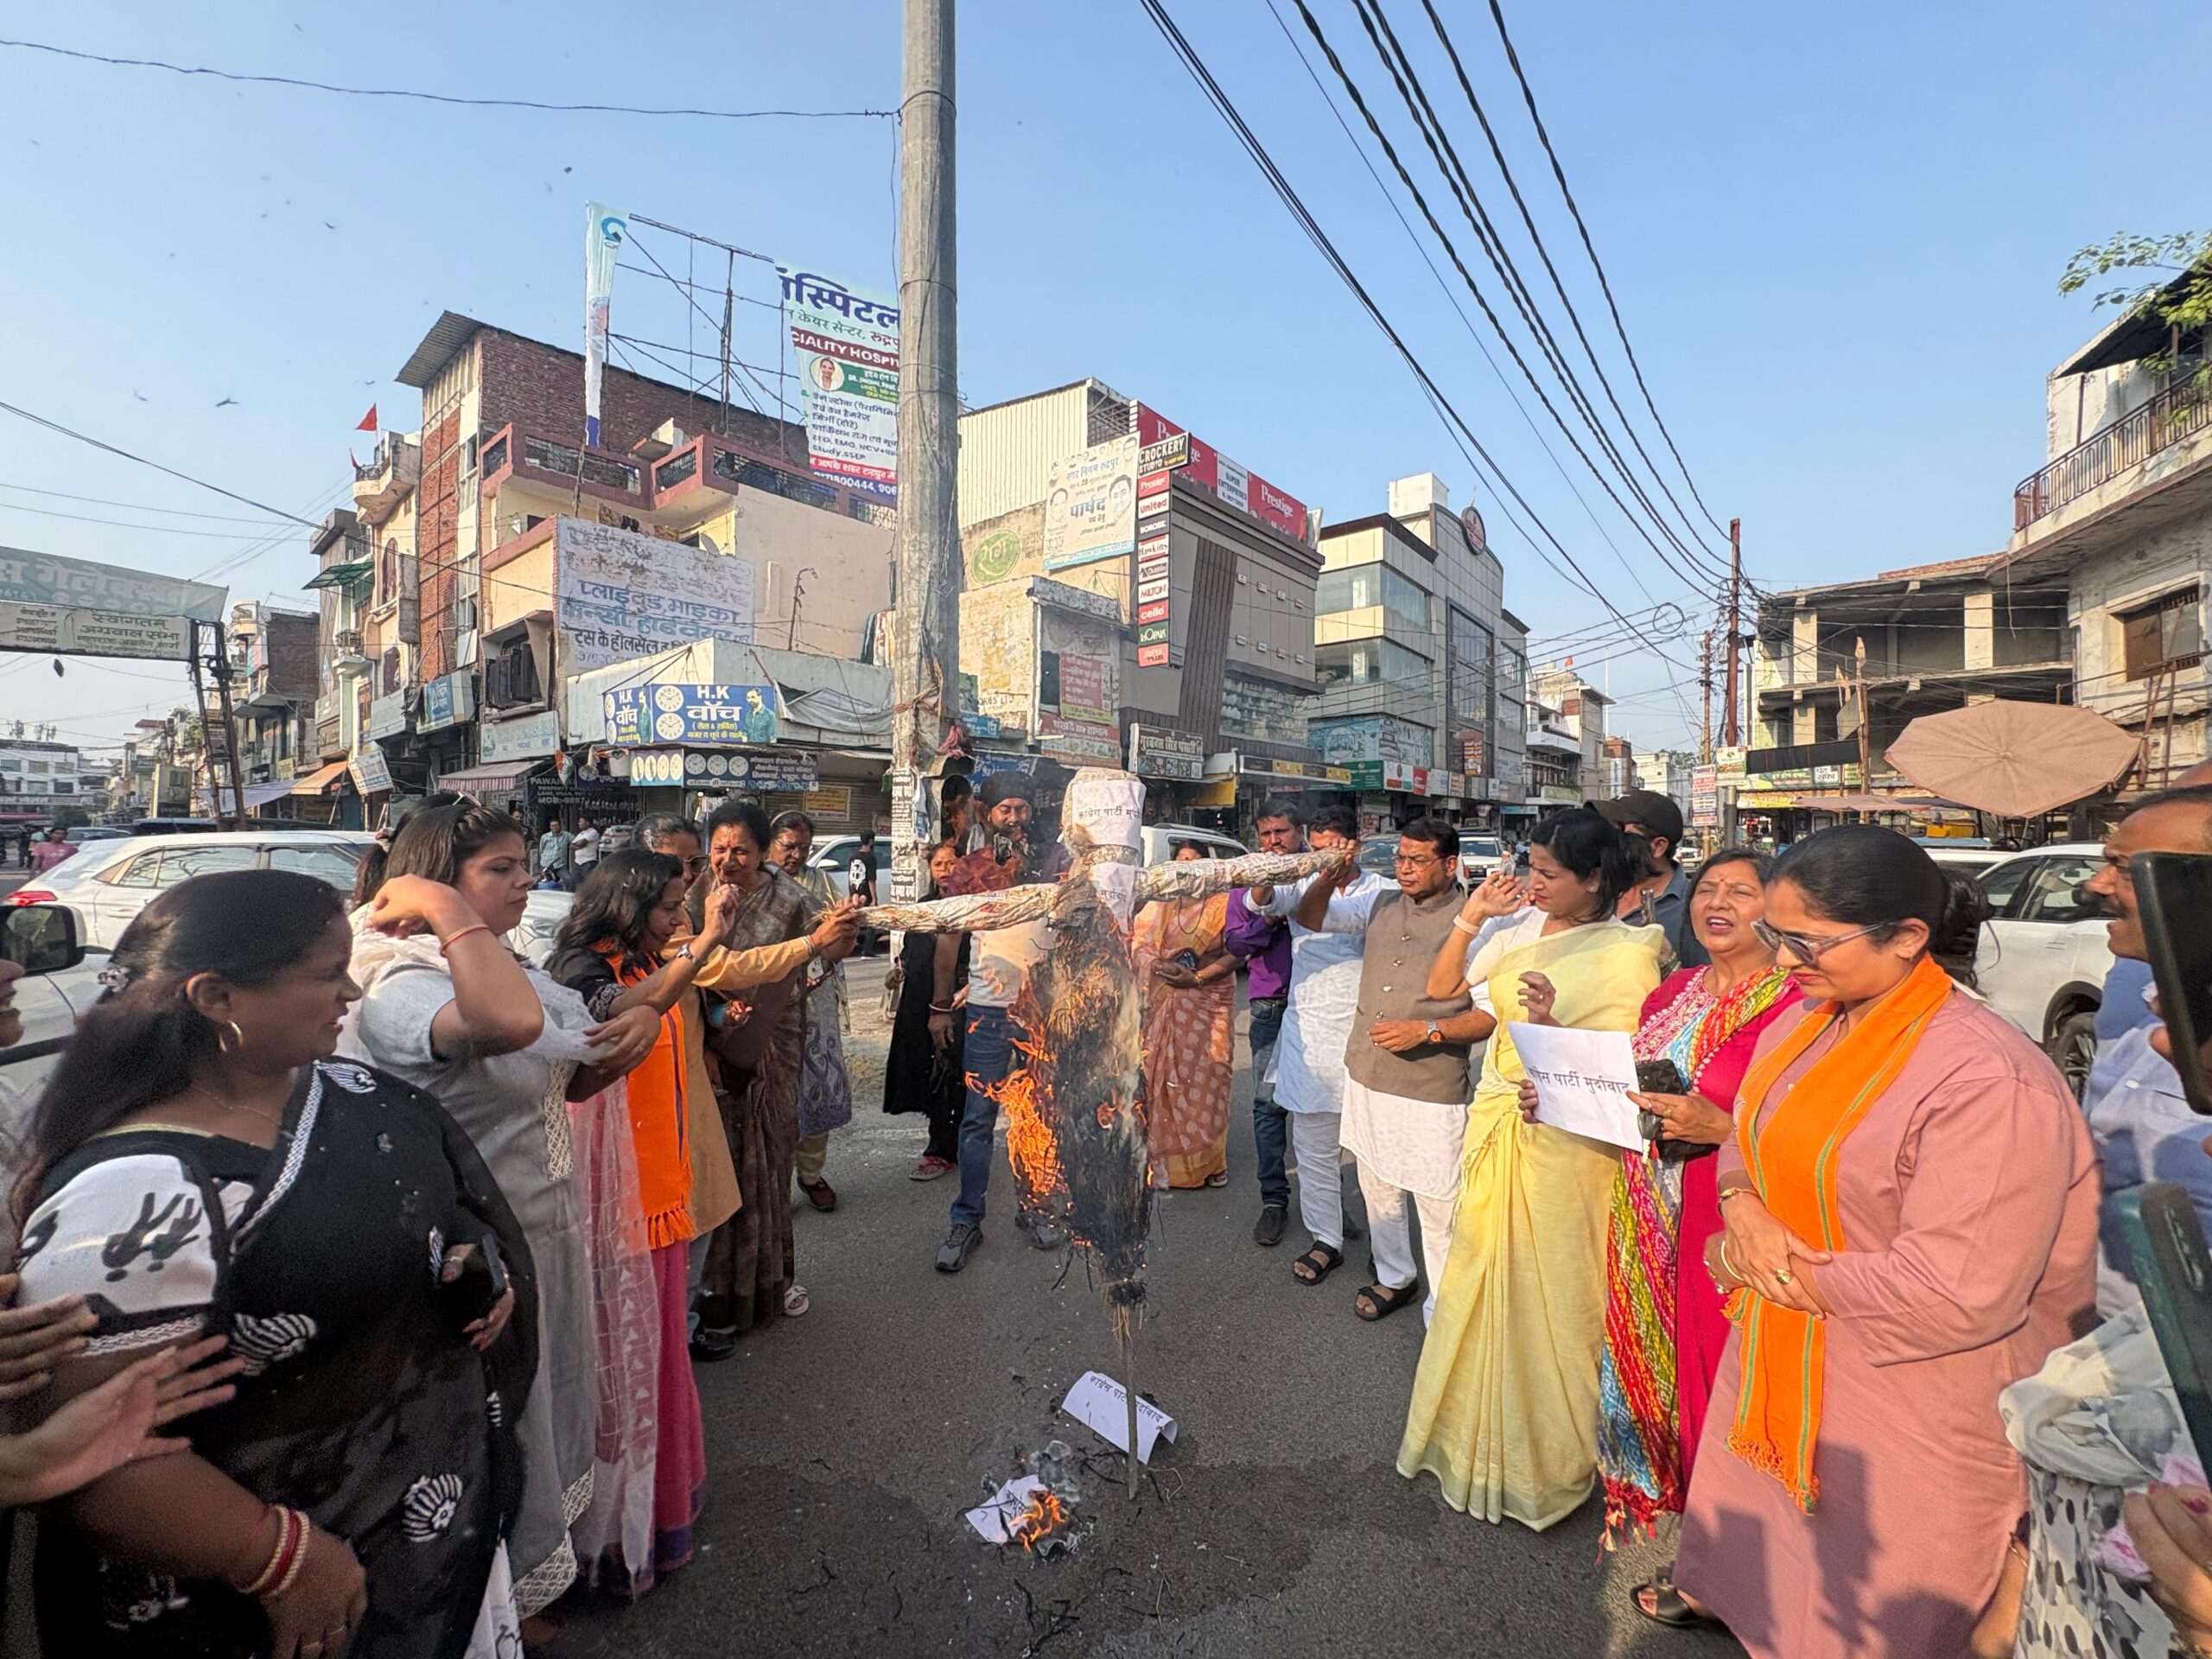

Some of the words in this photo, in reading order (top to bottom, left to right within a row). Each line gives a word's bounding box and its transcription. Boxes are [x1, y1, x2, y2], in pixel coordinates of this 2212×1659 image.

[1139, 437, 1185, 464] CROCKERY
[1139, 458, 1163, 474] STUDIO
[1141, 476, 1167, 491] Prestige
[1070, 493, 1108, 518] पार्षद
[1262, 484, 1294, 518] Prestige
[1140, 583, 1166, 598] MILTON
[92, 613, 170, 631] स्वागतम्
[1141, 607, 1165, 620] cello
[79, 625, 143, 638] अग्रवाल
[146, 631, 181, 641] सभा
[696, 685, 731, 700] H.K
[616, 704, 639, 725] वॉच
[686, 701, 743, 721] वॉच
[1103, 805, 1123, 817] पार्टी
[1554, 1071, 1580, 1089] पार्टी
